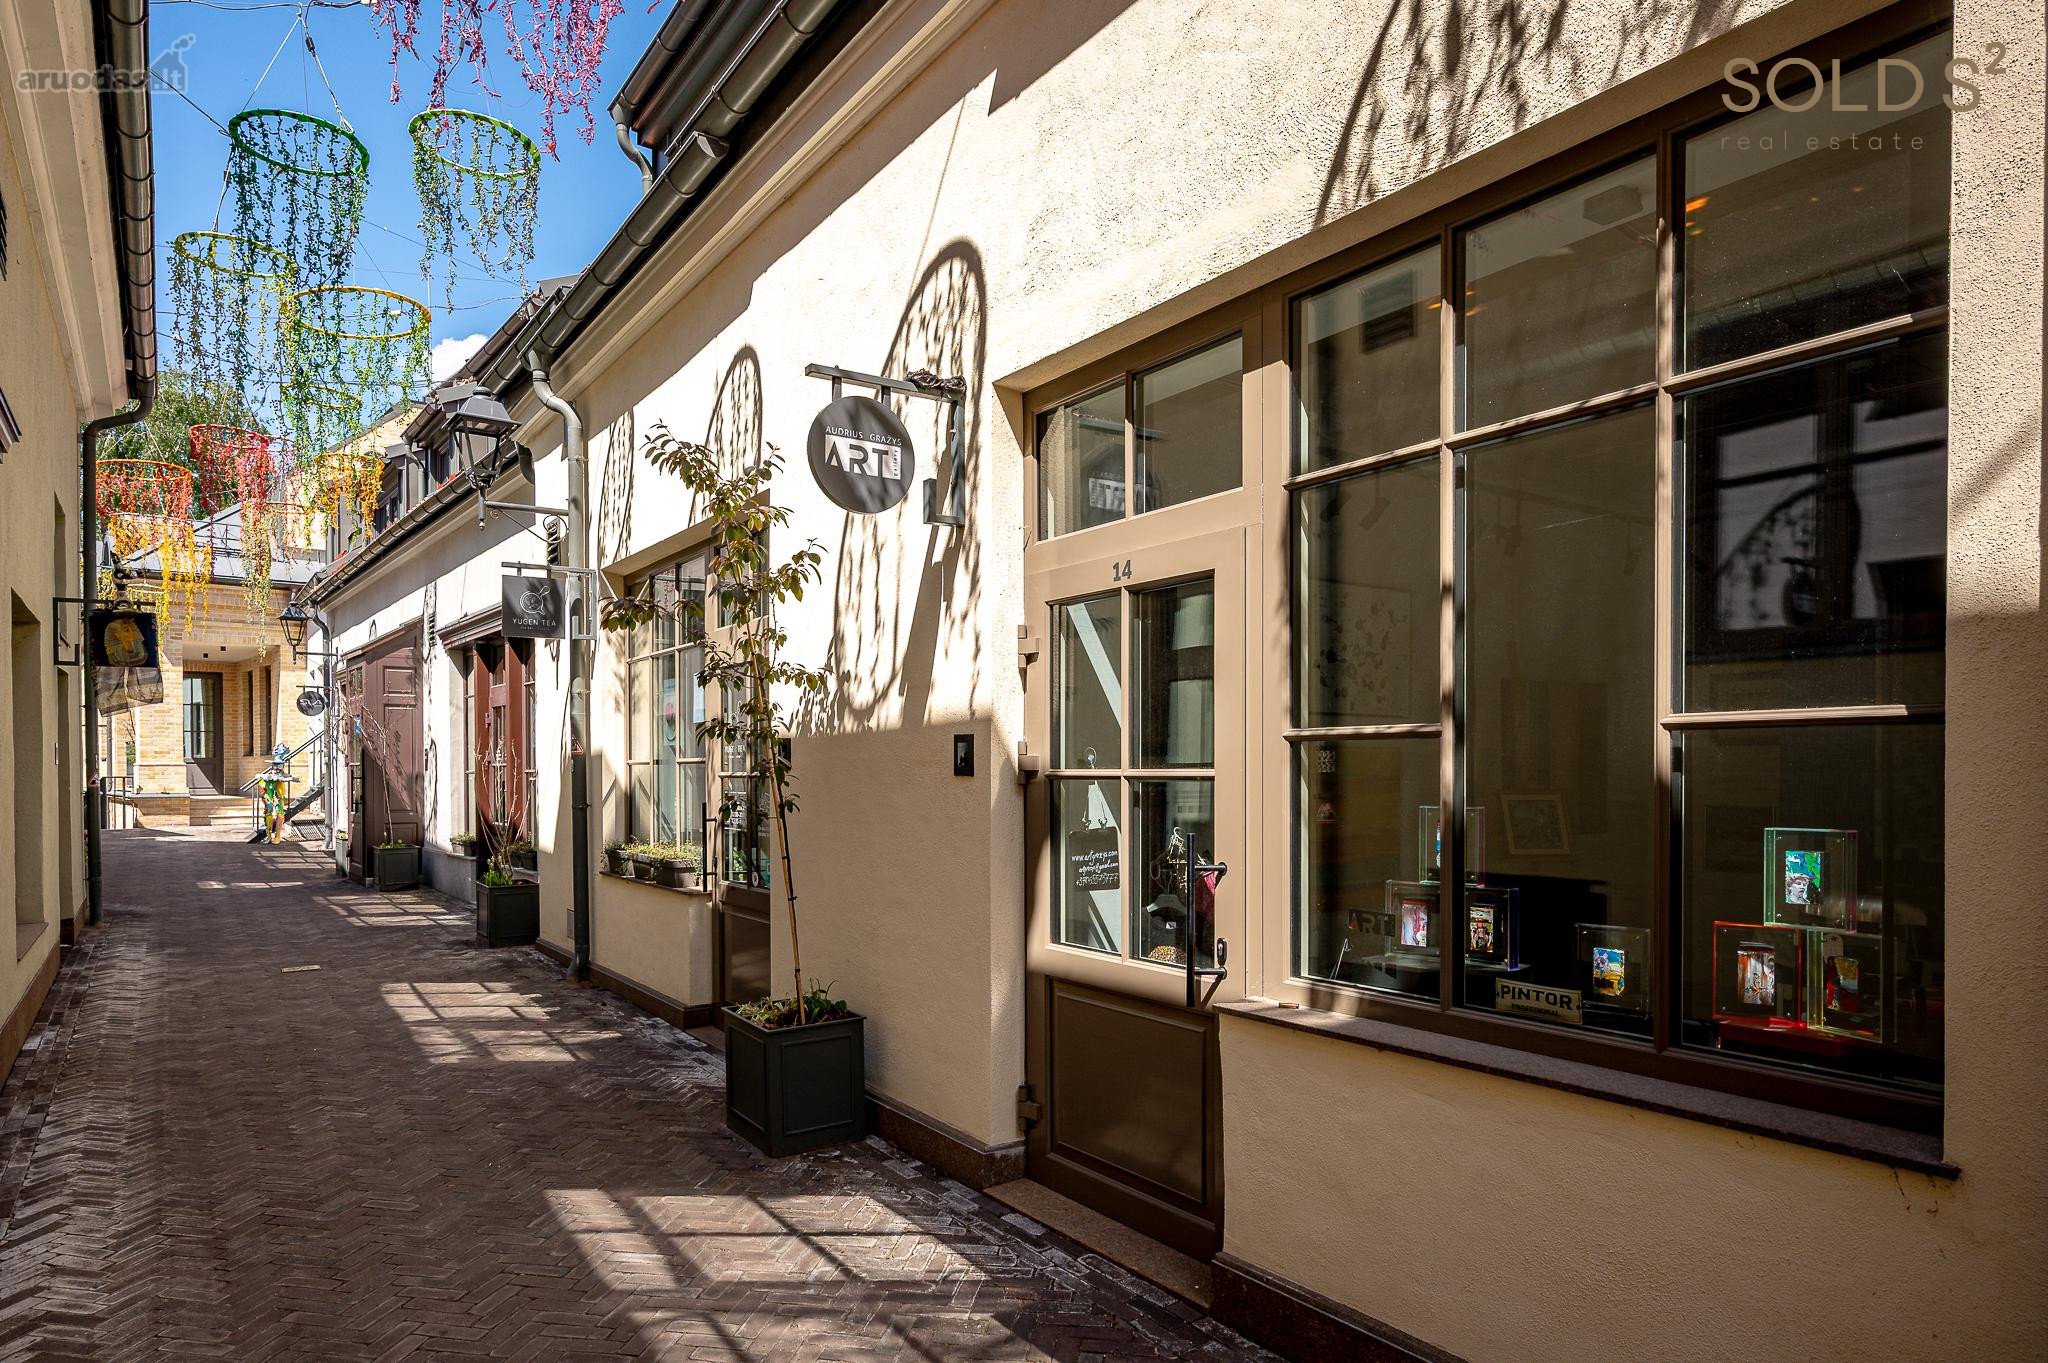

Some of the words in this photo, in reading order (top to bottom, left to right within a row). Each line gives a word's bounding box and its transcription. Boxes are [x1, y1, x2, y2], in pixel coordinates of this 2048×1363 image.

[825, 425, 863, 439] AUDRIUS
[825, 441, 889, 477] ART
[1112, 559, 1133, 582] 14
[512, 617, 539, 626] YUGEN
[1500, 984, 1574, 1011] PINTOR
